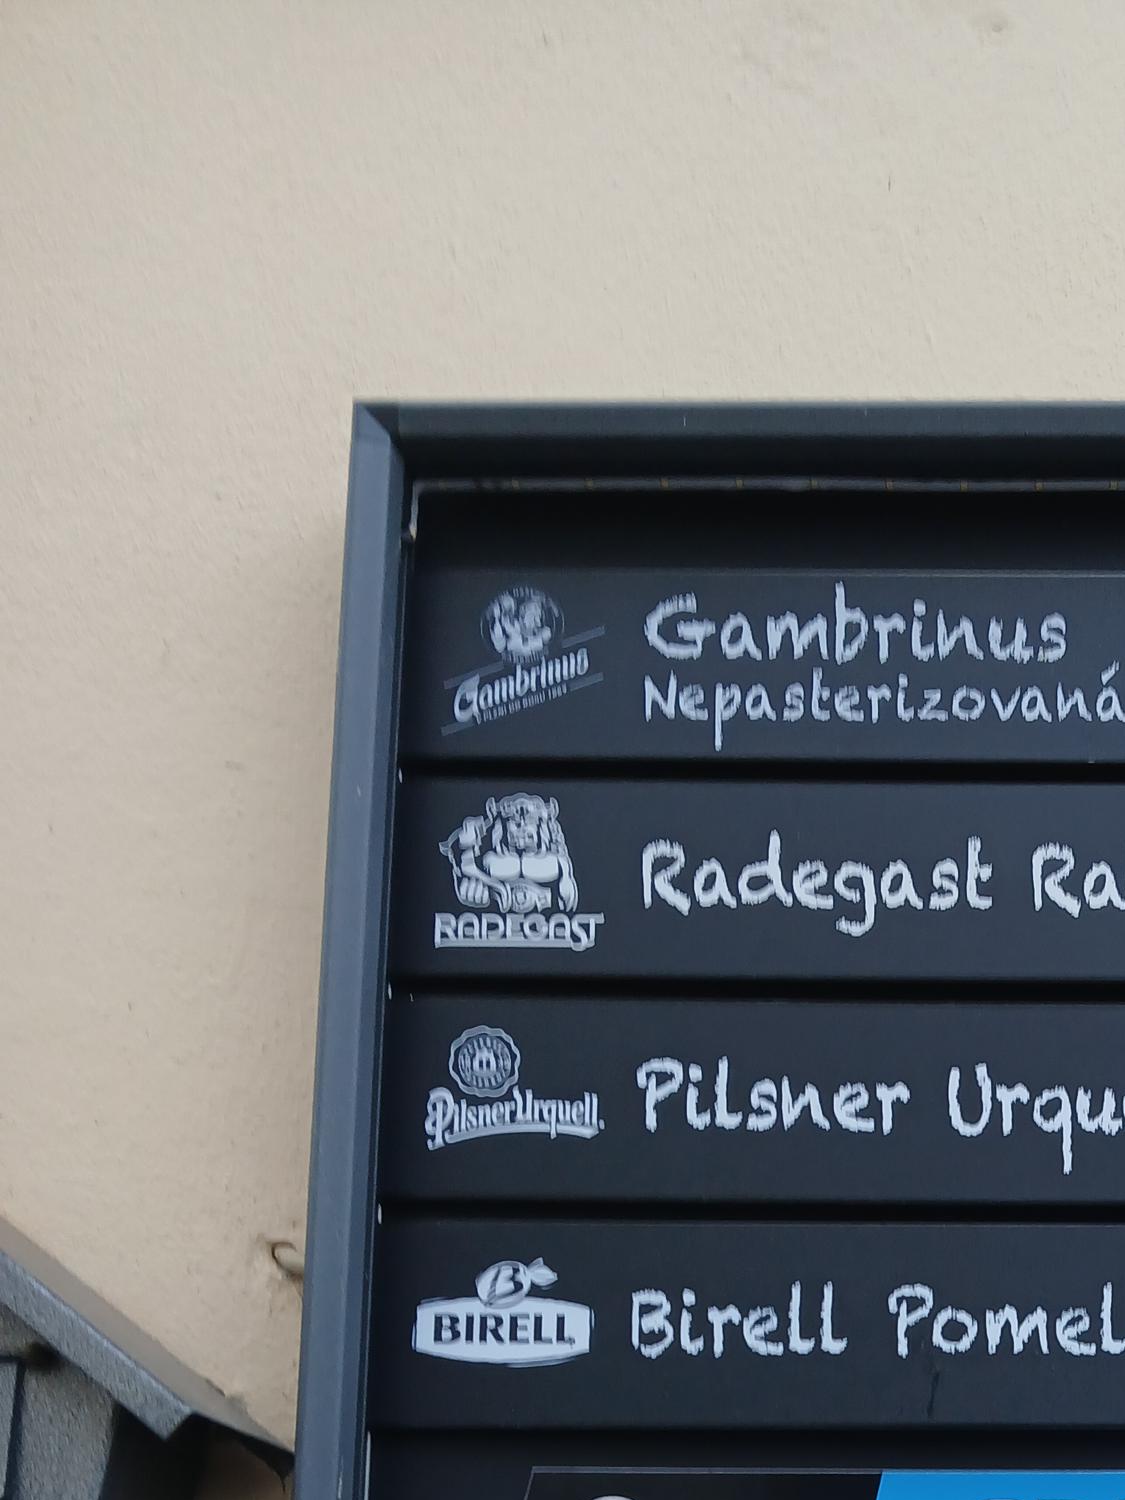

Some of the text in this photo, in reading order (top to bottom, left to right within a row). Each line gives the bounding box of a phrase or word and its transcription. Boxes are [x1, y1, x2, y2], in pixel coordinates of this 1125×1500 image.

[644, 582, 1066, 665] Gambrinus
[454, 648, 589, 724] Gambrinus
[643, 829, 992, 937] Radegast
[434, 912, 605, 951] RADEGAST
[425, 1087, 515, 1151] Pilsner
[637, 1056, 910, 1135] Pilsner
[434, 1312, 576, 1345] BIRELL
[632, 1281, 848, 1359] Birell
